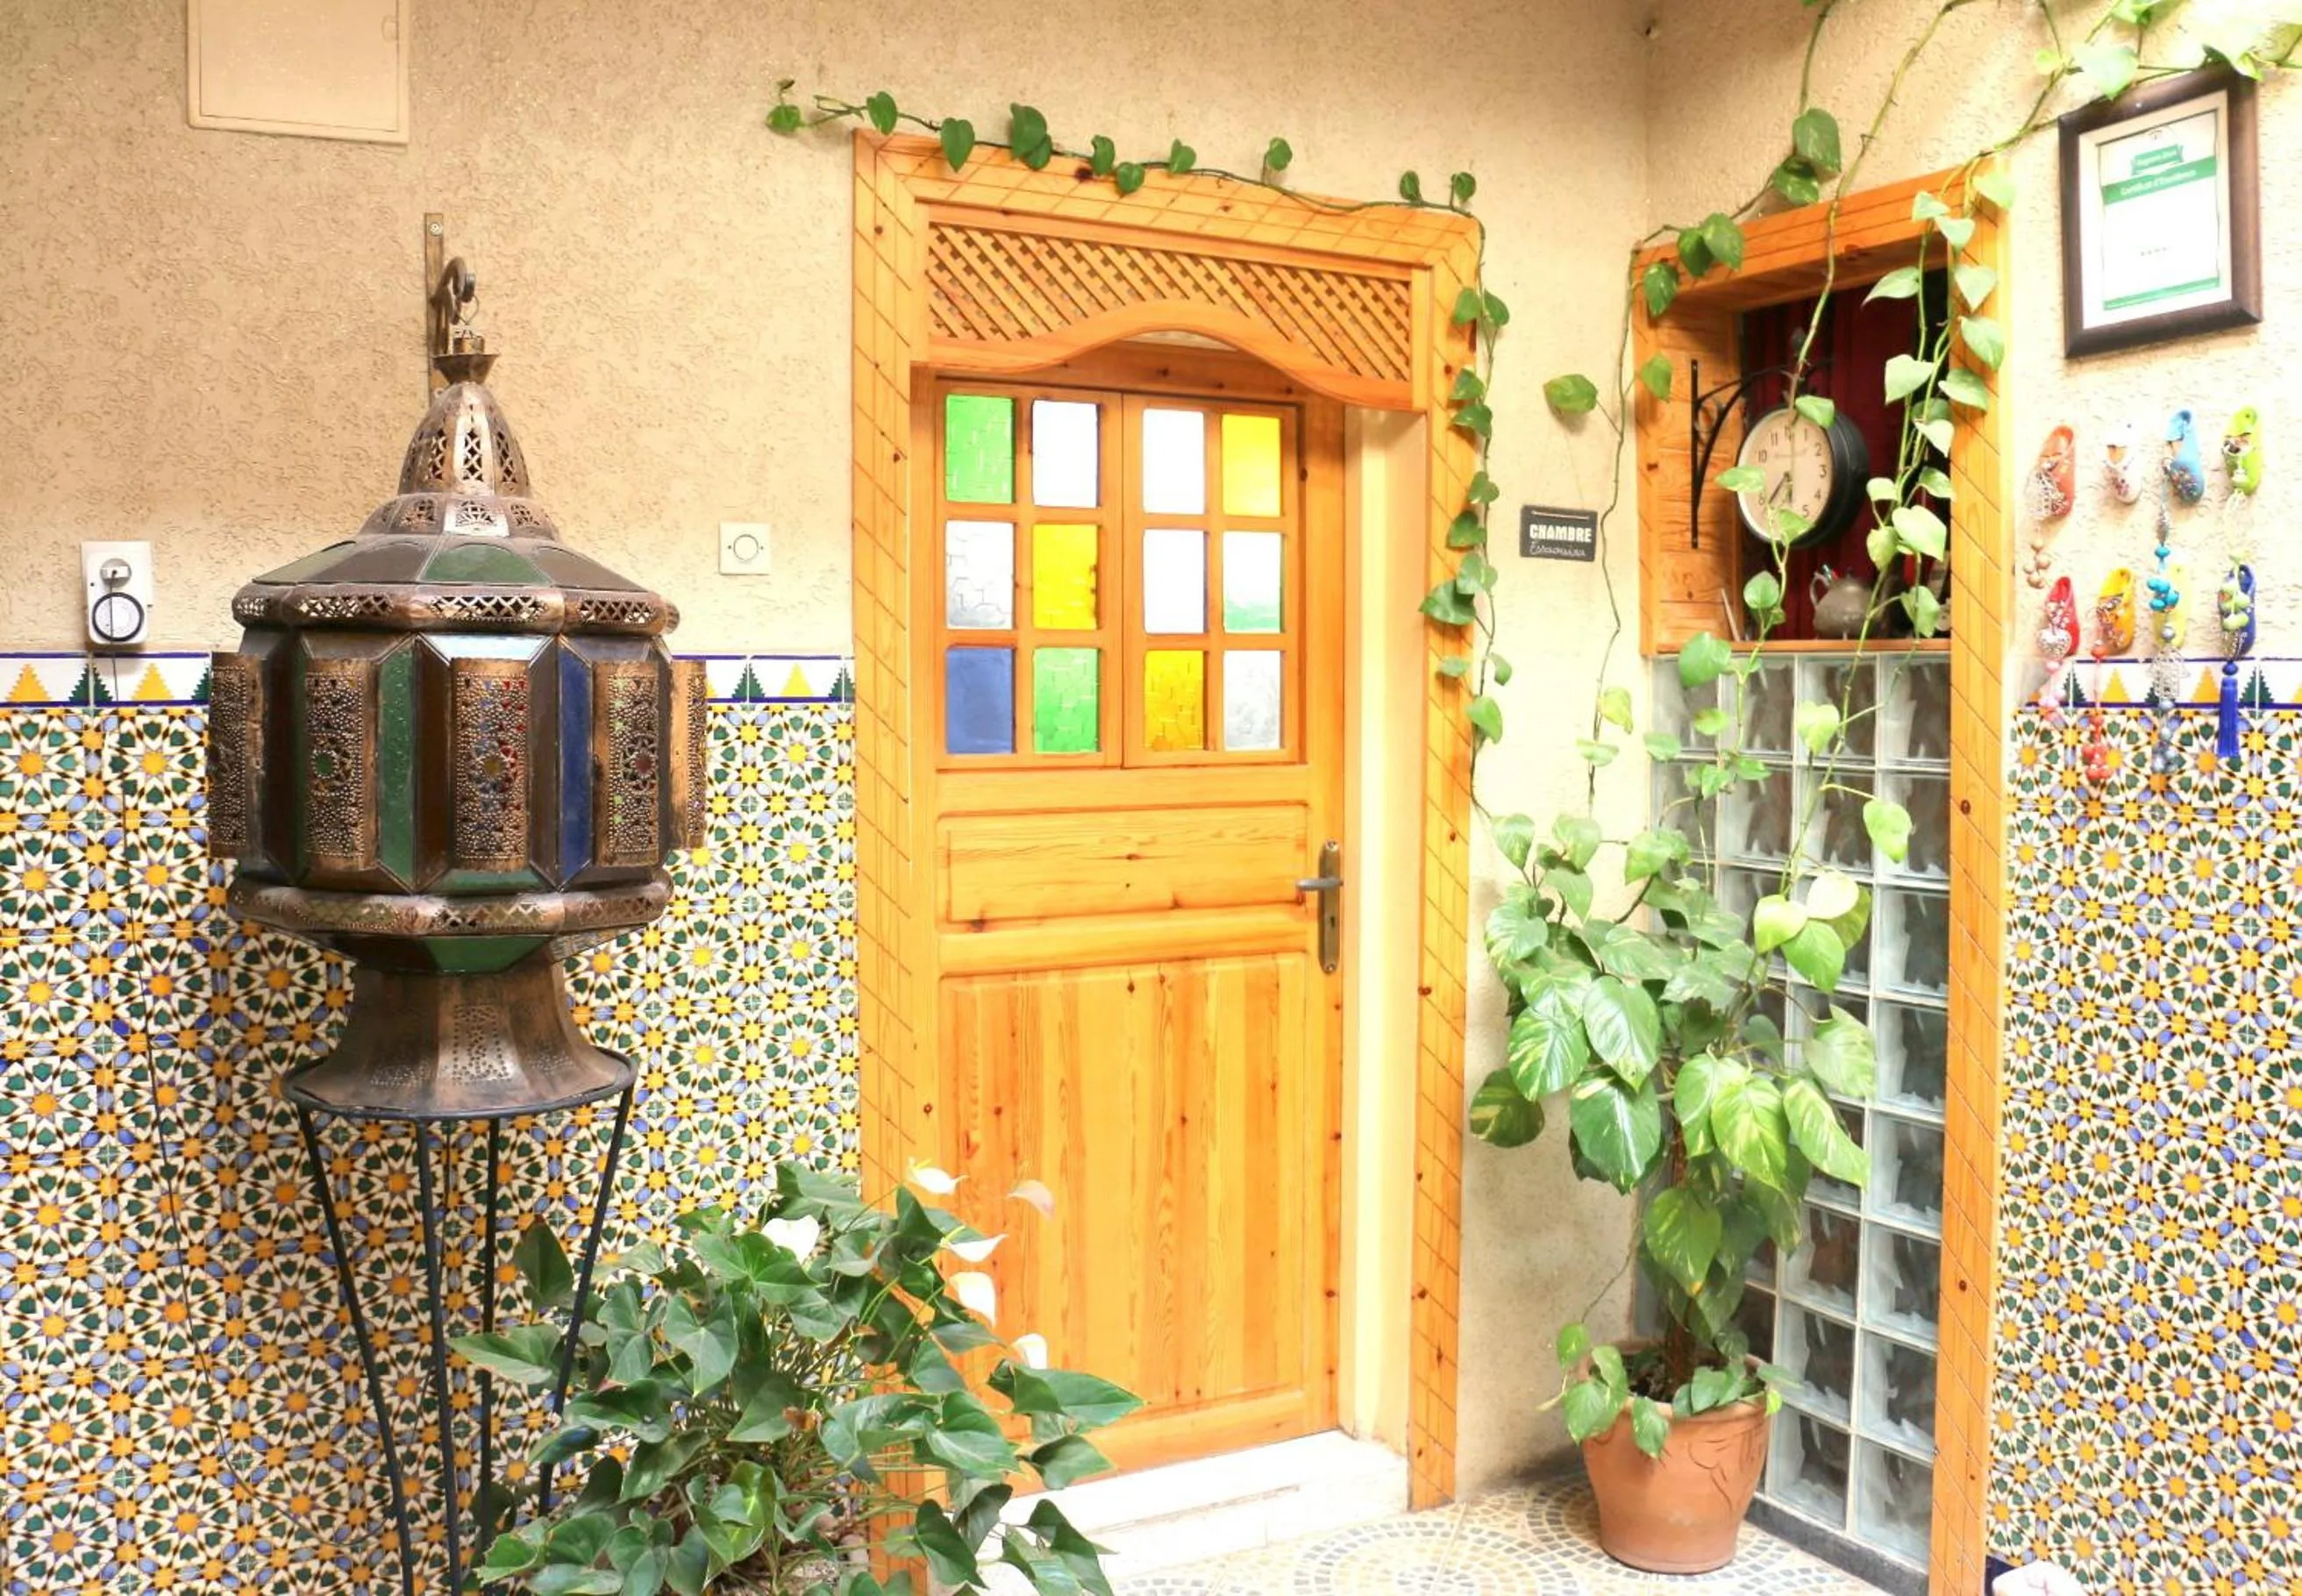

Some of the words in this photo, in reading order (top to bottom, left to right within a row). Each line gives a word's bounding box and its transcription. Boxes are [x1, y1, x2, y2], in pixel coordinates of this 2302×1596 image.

[1758, 449, 1768, 464] 10
[1814, 442, 1822, 457] 2
[1819, 464, 1827, 479] 3
[1814, 488, 1821, 500] 4
[1802, 504, 1810, 518] 5
[1529, 524, 1593, 544] CHAMBRE
